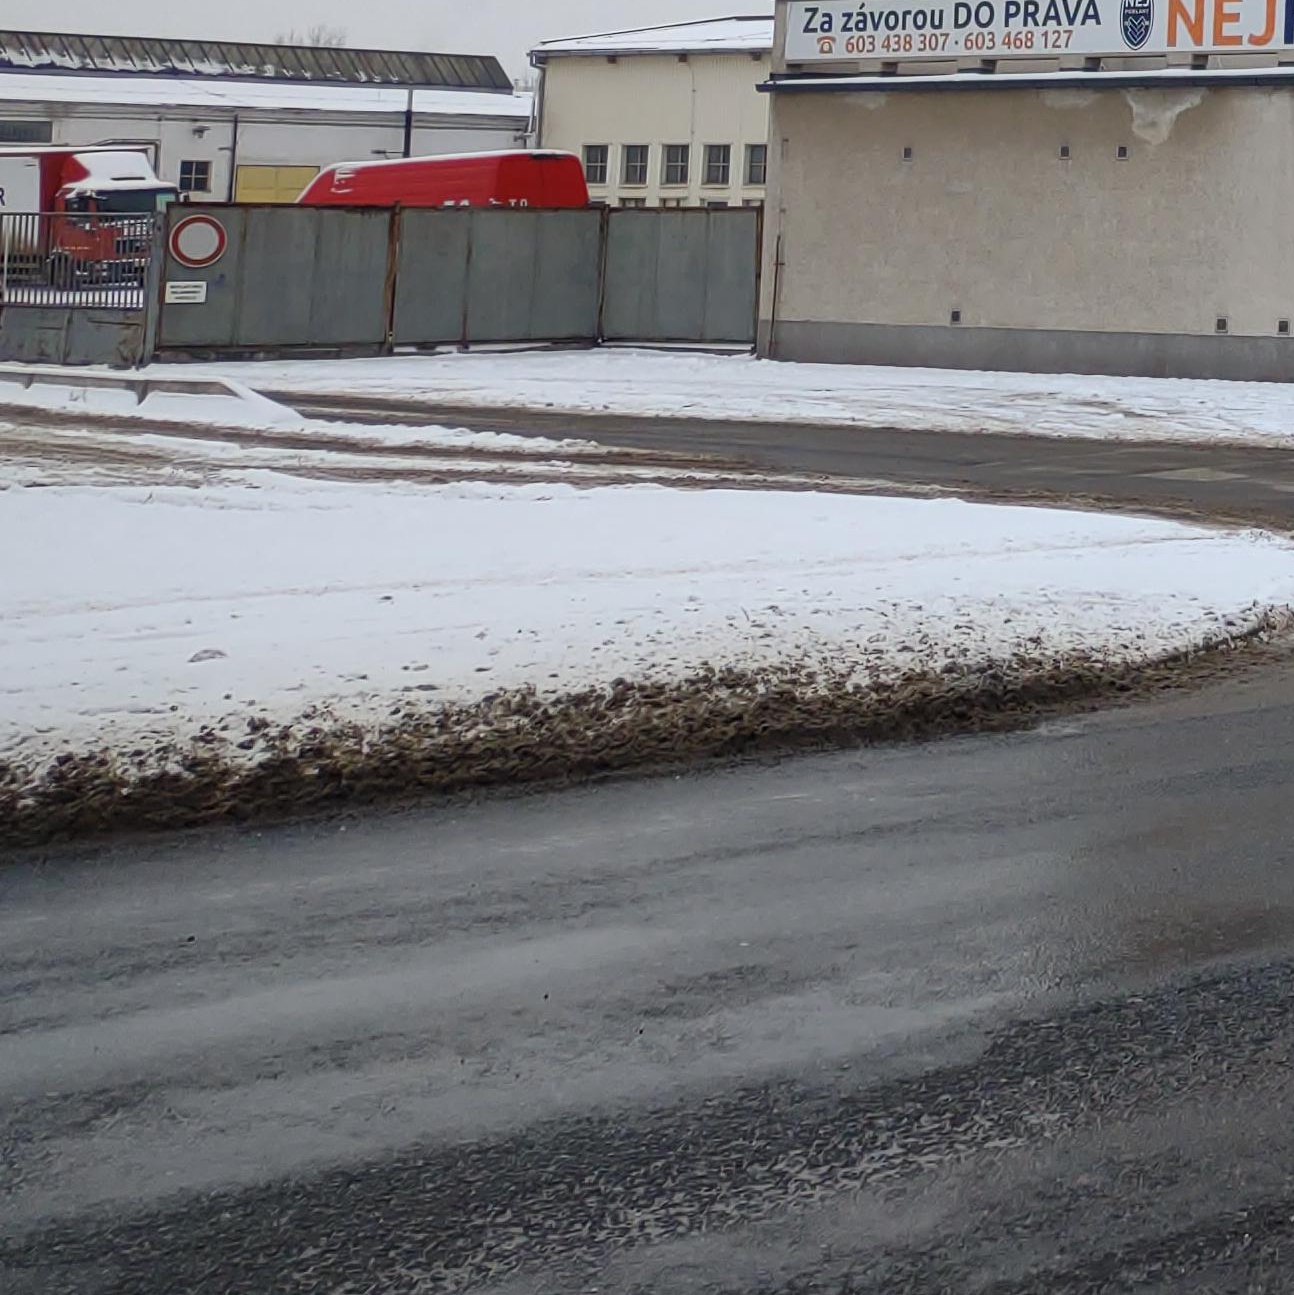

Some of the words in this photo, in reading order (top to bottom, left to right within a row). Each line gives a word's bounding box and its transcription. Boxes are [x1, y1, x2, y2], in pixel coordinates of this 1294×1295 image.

[803, 7, 833, 33] Za
[841, 2, 944, 32] závorou
[954, 1, 995, 29] DO
[845, 34, 876, 53] 603
[881, 34, 912, 53] 438
[918, 33, 950, 52] 307
[964, 31, 996, 50] 603
[1002, 30, 1035, 49] 468
[1041, 29, 1074, 49] 127
